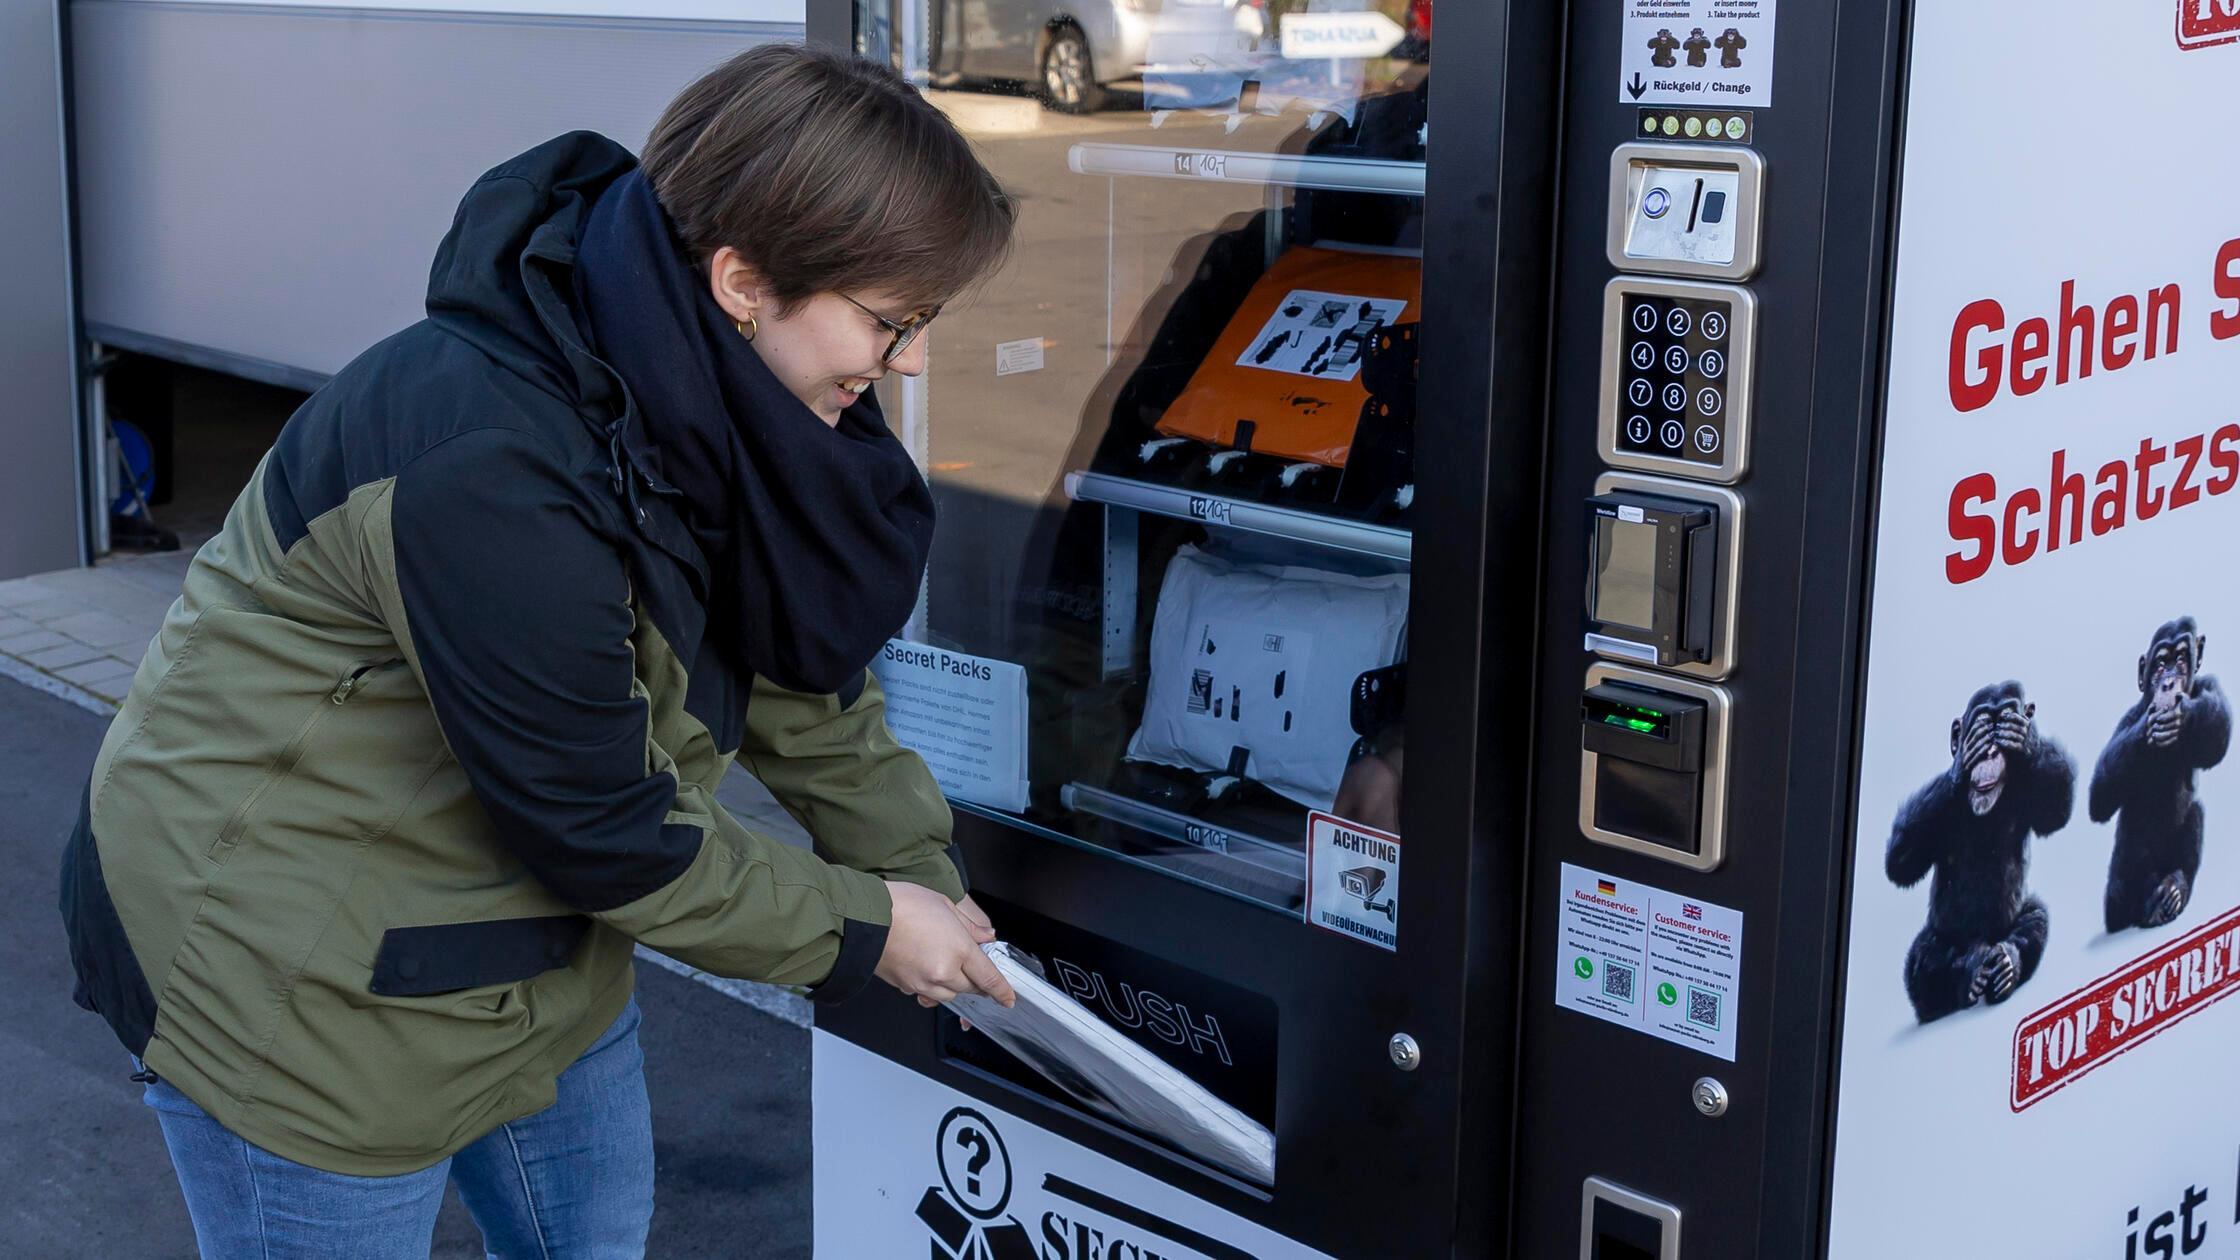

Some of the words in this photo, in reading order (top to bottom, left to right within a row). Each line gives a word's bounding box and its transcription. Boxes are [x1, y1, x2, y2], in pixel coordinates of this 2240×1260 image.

[1738, 11, 1760, 19] product
[1653, 80, 1700, 94] Rückgeld
[1712, 82, 1751, 94] Change
[1177, 156, 1190, 171] 14
[1642, 311, 1648, 326] 1
[1674, 315, 1683, 330] 2
[1709, 318, 1718, 333] 3
[1948, 279, 2181, 413] Gehen
[1638, 348, 1647, 362] 4
[1672, 352, 1681, 367] 5
[1706, 357, 1715, 371] 6
[1636, 386, 1645, 399] 7
[1670, 390, 1679, 404] 8
[1705, 394, 1713, 409] 9
[1668, 427, 1676, 442] 0
[1192, 500, 1205, 515] 12
[1945, 424, 2240, 584] Schatzs
[884, 642, 936, 670] Secret
[941, 654, 991, 681] Packs
[1187, 826, 1200, 842] 10
[1333, 829, 1396, 864] ACHTUNG
[1575, 889, 1638, 915] Kundenservice:
[1655, 912, 1696, 932] Customer
[1698, 924, 1731, 942] service:
[1053, 958, 1232, 1065] PUSH
[2025, 1002, 2100, 1086] TOP
[2126, 1184, 2208, 1260] ist
